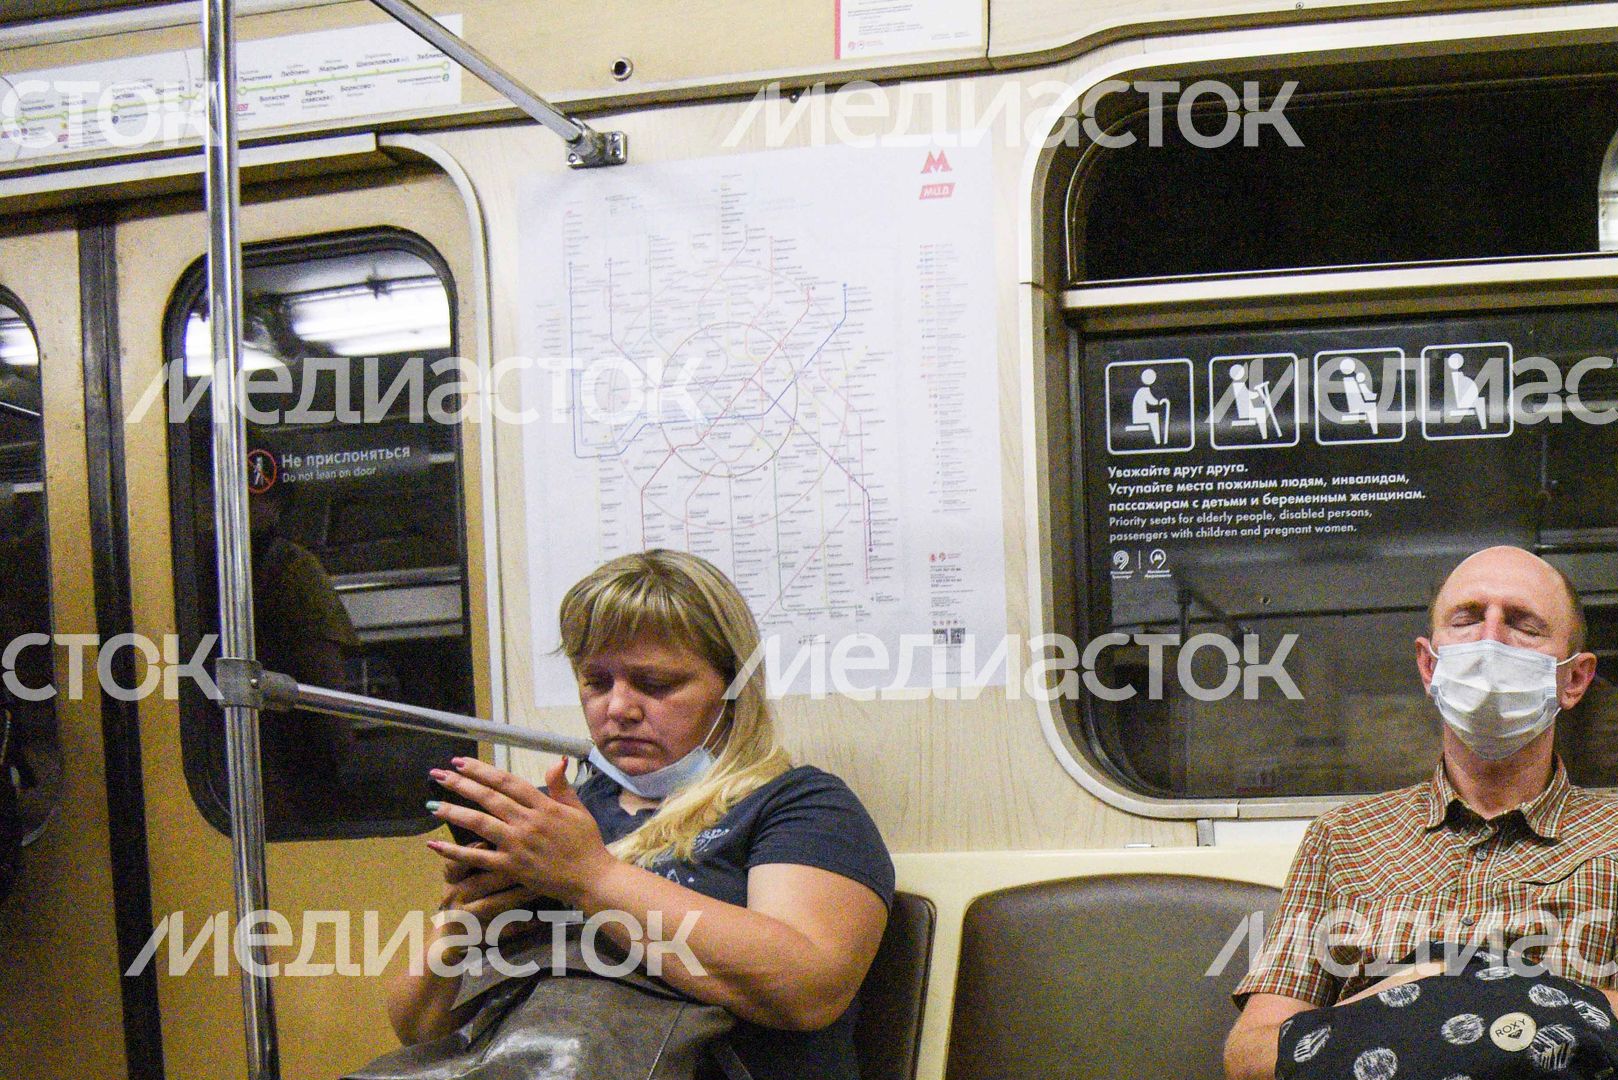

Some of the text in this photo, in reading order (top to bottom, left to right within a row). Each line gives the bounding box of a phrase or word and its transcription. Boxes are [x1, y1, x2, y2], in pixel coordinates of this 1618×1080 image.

[282, 446, 411, 469] Не прислоняться
[282, 465, 377, 483] Do not lean on door
[1107, 463, 1249, 479] Уважайте друг друга.
[1108, 474, 1410, 497] Уступайте места пожилым людям, инвалидам,
[1108, 490, 1427, 512] пассажирам с детьми и беременным женщинам.
[1108, 507, 1373, 528] Priority seats for elderly people, disabled persons,
[1109, 523, 1358, 544] passengers with children and pregnant women.
[1495, 1018, 1526, 1037] ROXY
